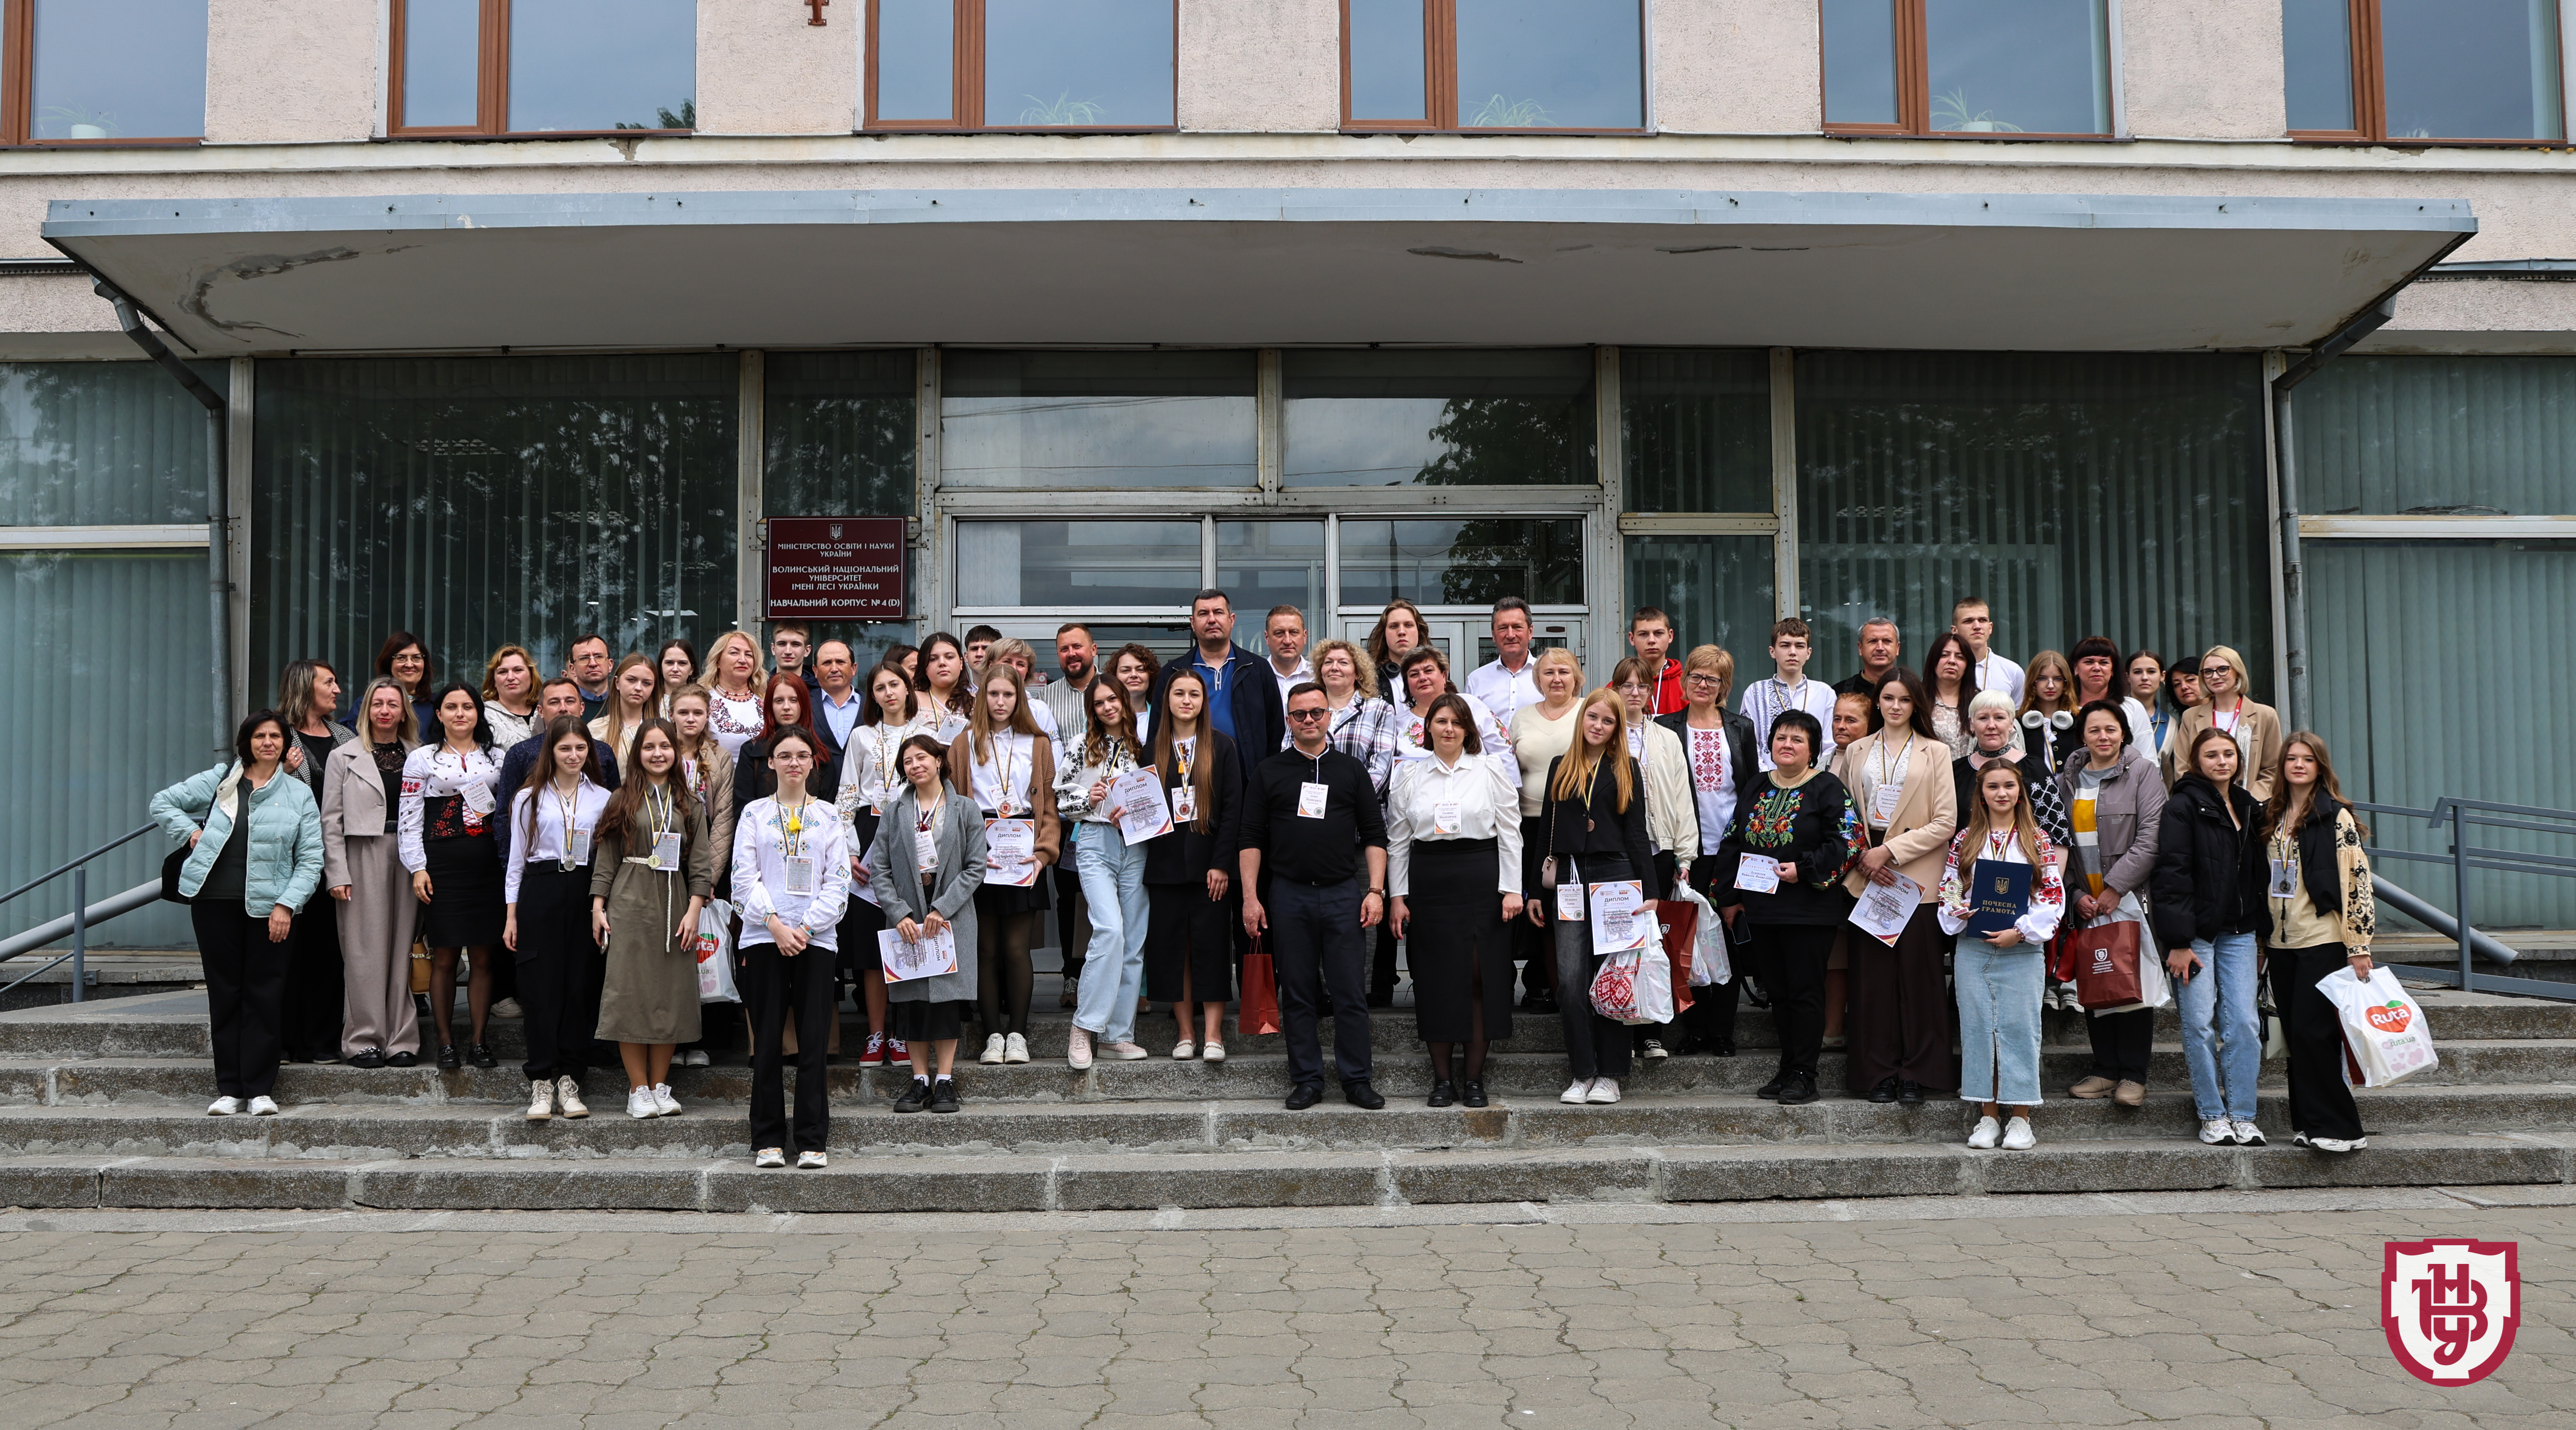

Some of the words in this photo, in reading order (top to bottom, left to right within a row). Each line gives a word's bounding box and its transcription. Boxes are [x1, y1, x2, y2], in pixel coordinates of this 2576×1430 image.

[772, 565, 830, 573] ВОЛИНСЬКИЙ
[833, 565, 899, 573] НАЦІОНАЛЬНИЙ
[838, 582, 879, 590] УКРАЇНКИ
[770, 598, 828, 607] НАВЧАЛЬНИЙ
[1125, 782, 1148, 793] ДИПЛОМ
[1895, 884, 1909, 895] ПЛОМ
[1982, 899, 2017, 909] ПОЧЕСНА
[1981, 906, 2016, 915] ГРАМОТА
[933, 936, 941, 961] ДИПЛОМ
[2371, 1009, 2409, 1025] Ruta
[2390, 1037, 2416, 1047] ruta.ua
